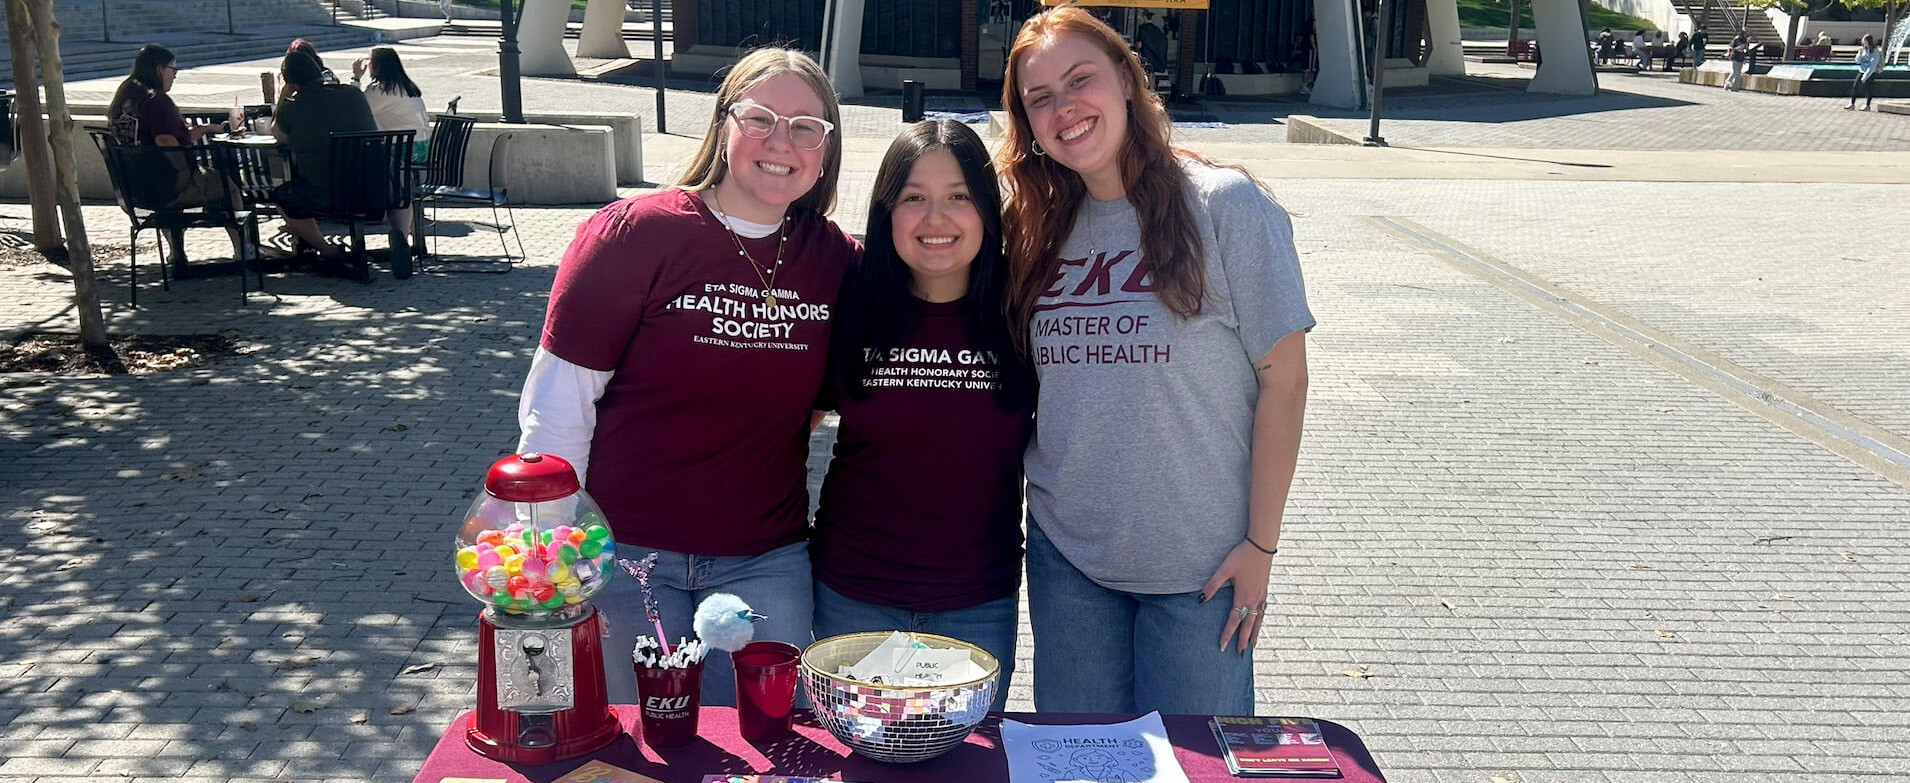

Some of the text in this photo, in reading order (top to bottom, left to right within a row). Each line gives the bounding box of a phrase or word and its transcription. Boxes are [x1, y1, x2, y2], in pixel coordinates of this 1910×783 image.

[705, 283, 800, 300] ETA SIGMA GAMMA
[752, 302, 830, 321] HONORS
[712, 317, 794, 339] SOCIETY
[1035, 315, 1149, 338] MASTER OF
[693, 335, 809, 351] EASTERN KENTUCKY UNIVERSITY
[888, 347, 952, 364] SIGMA
[1086, 344, 1170, 364] HEALTH
[910, 368, 969, 378] HONORARY
[907, 379, 962, 389] KENTUCKY
[646, 695, 690, 710] EKU
[666, 711, 690, 720] HEALTH
